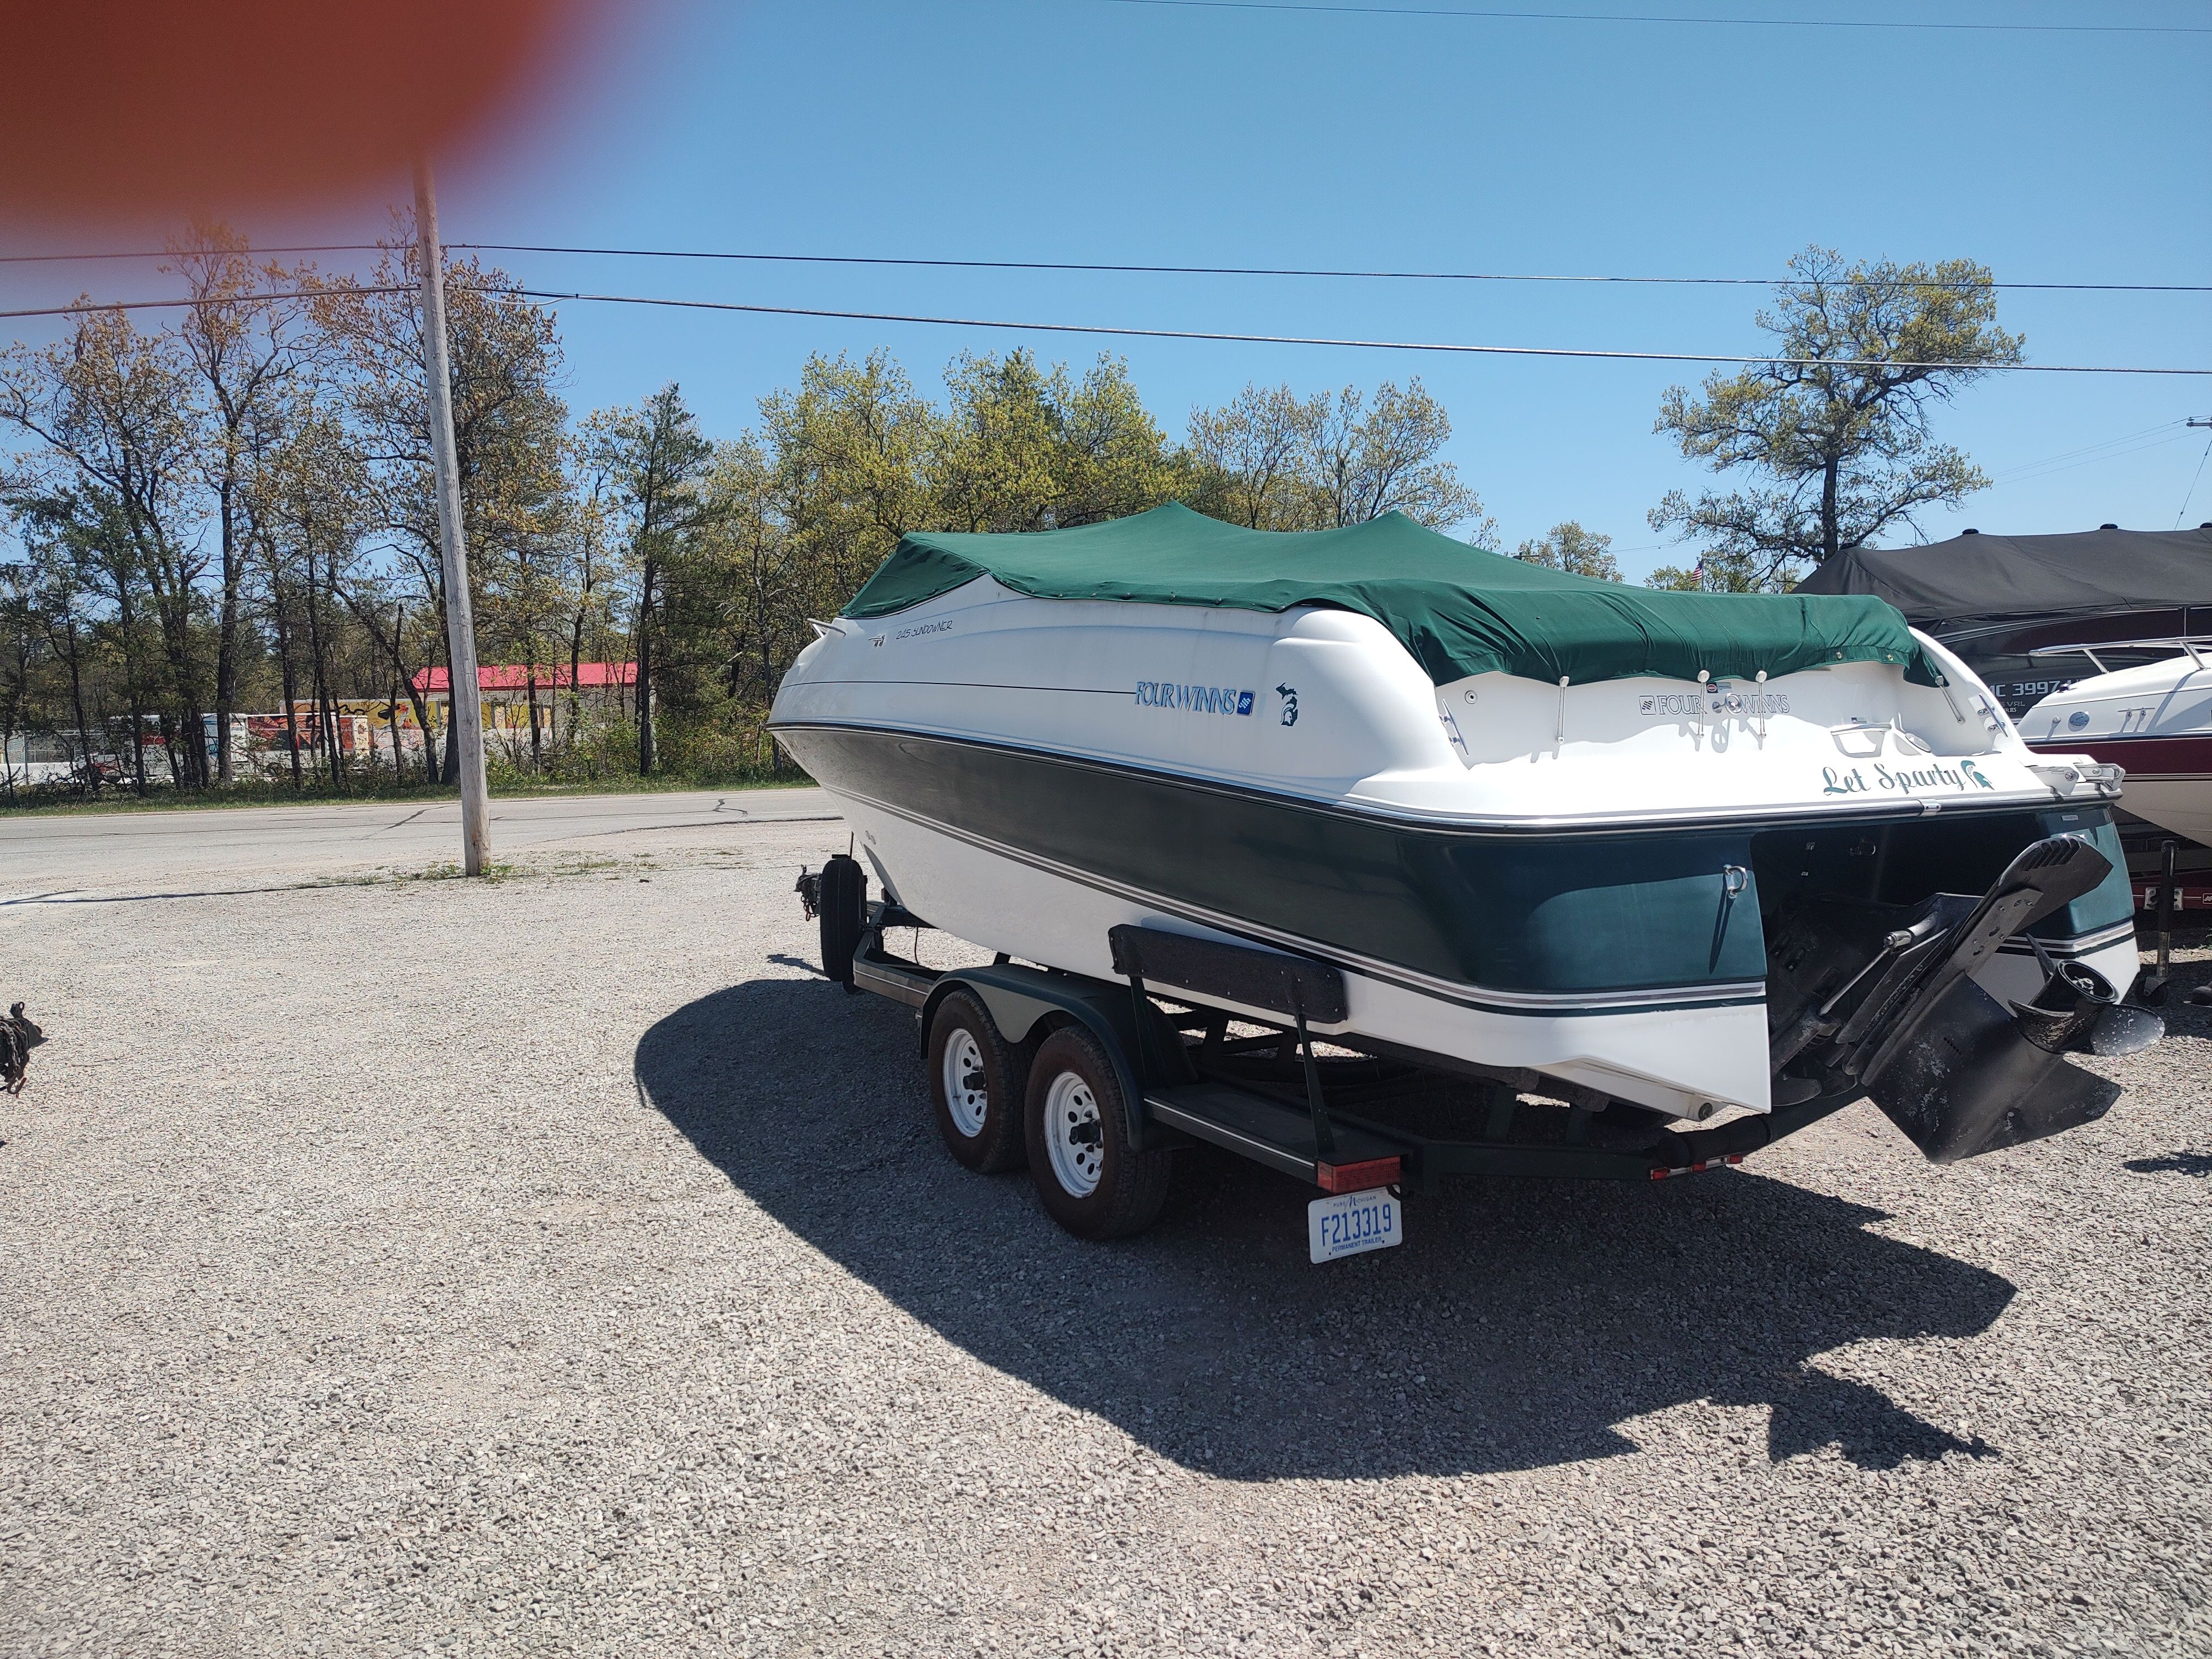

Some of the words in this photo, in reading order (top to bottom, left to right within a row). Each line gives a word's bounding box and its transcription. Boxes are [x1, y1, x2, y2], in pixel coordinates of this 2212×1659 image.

[896, 628, 911, 640] 245
[911, 620, 953, 637] SUNDOWNER
[1134, 681, 1175, 709] FOUR
[1176, 685, 1237, 715] WINNS
[2012, 681, 2060, 696] 3997
[1657, 695, 1708, 715] FOUR
[1823, 766, 1871, 796] Let
[1874, 763, 1966, 795] Sparty
[1321, 1203, 1392, 1247] F213319
[1332, 1240, 1361, 1253] PERMANENT
[1361, 1237, 1382, 1245] TRAILER
